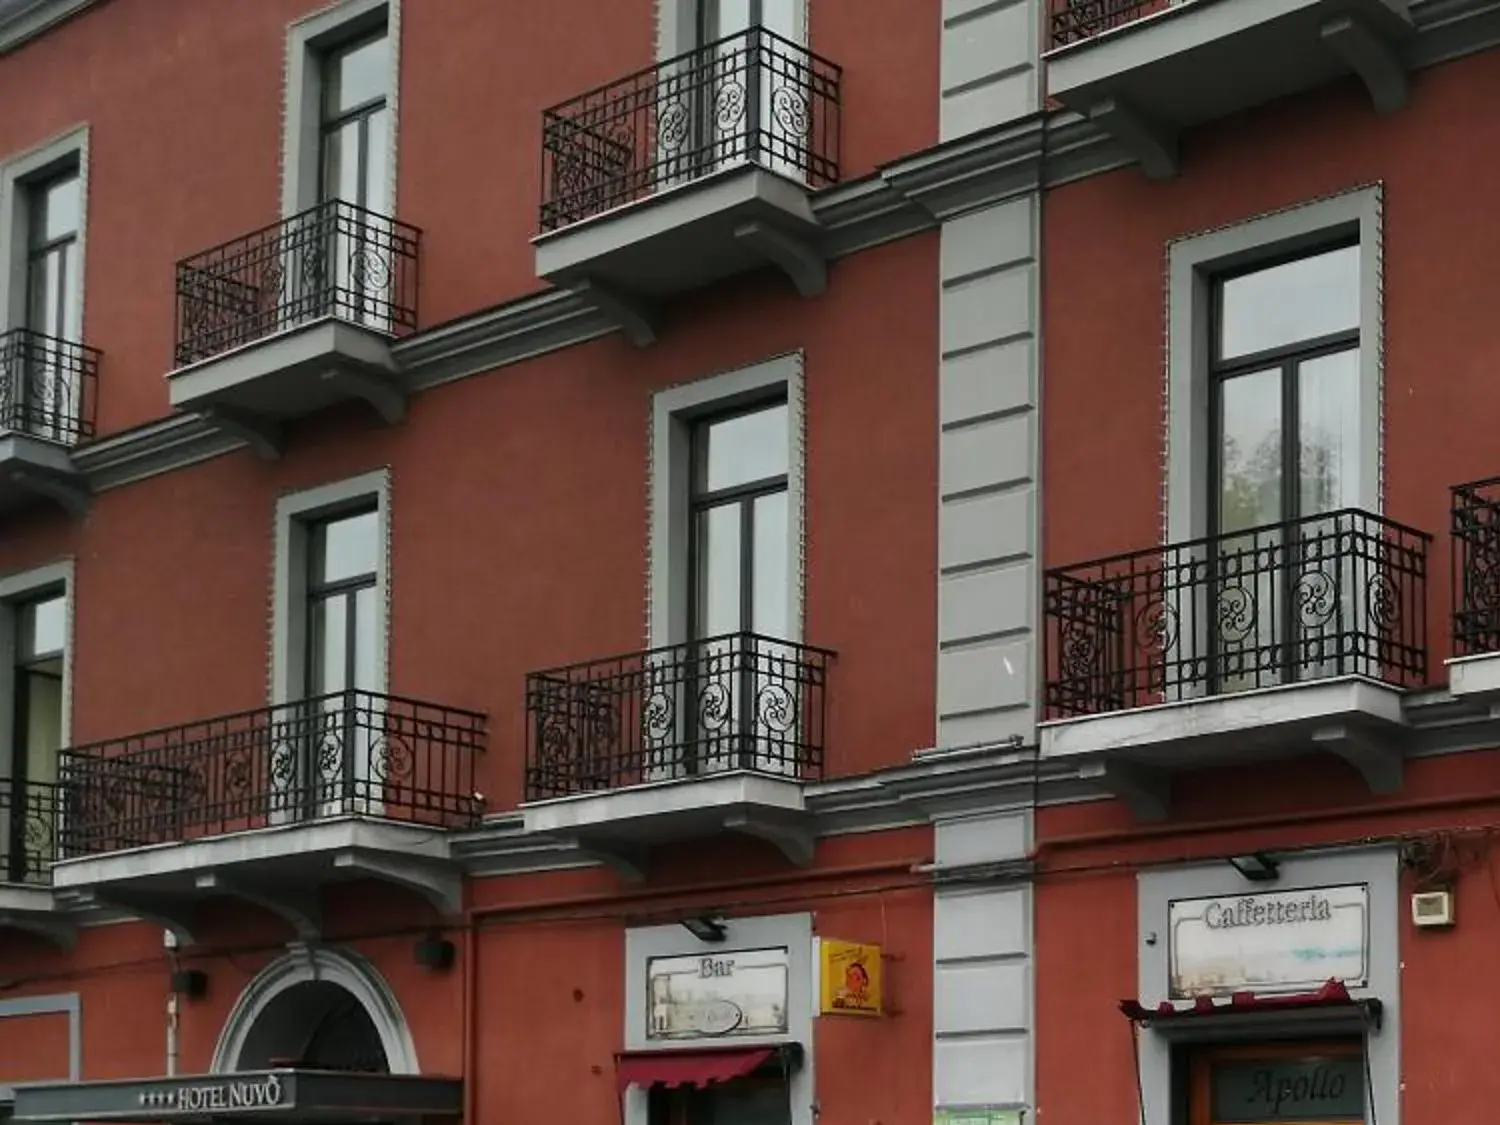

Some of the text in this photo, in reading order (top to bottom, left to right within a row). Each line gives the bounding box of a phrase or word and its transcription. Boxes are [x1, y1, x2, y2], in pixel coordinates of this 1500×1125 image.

[1204, 895, 1333, 930] Caffetteria
[698, 957, 735, 979] Bar
[178, 1086, 226, 1111] HOTEL
[1246, 1065, 1346, 1115] Apollo
